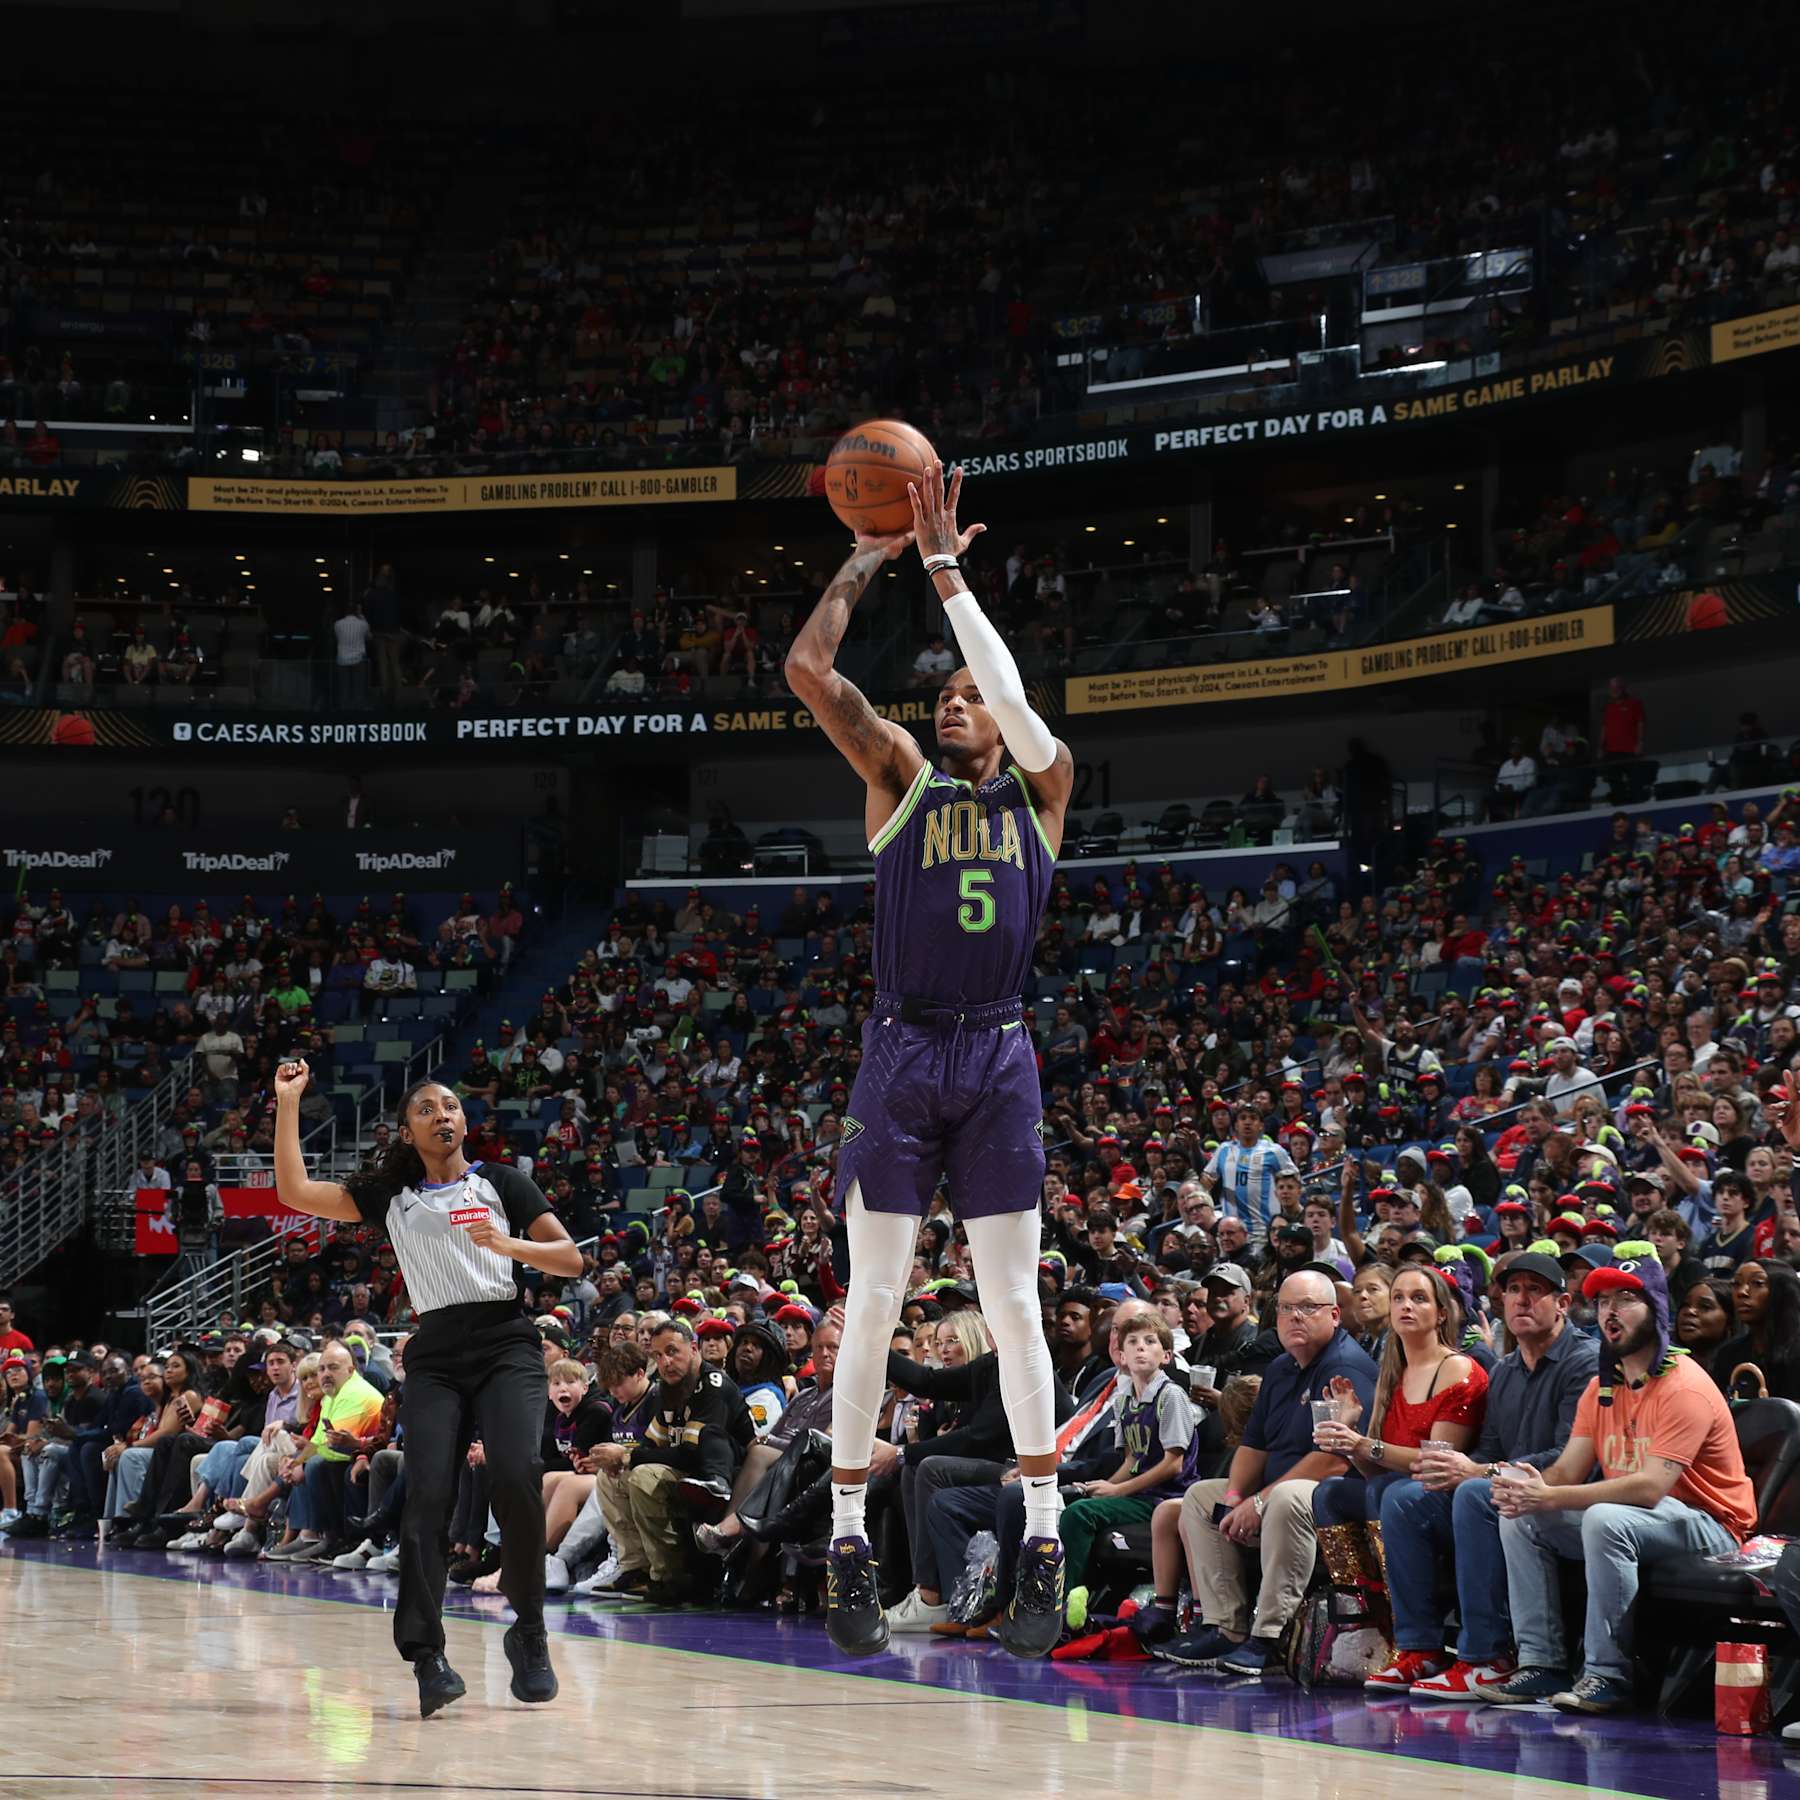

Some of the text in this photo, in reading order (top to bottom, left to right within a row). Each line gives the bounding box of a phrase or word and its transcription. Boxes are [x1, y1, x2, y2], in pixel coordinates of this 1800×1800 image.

[1154, 355, 1616, 452] PERFECT DAY FOR A SAME GAME PARLAY
[1024, 438, 1129, 470] SPORTSBOOK
[481, 476, 718, 501] GAMBLING PROBLEM? CALL 1-800-GAMBLER
[1361, 618, 1585, 675] GAMBLING PROBLEM? CALL 1-800-GAMBLER
[1088, 682, 1109, 691] Must
[1111, 681, 1121, 690] be
[1138, 677, 1156, 687] and
[1157, 673, 1200, 686] physically
[1202, 671, 1235, 683] present
[1266, 664, 1290, 675] Know
[1293, 662, 1316, 673] When
[1318, 660, 1328, 670] To
[1088, 694, 1108, 704] Stop
[1110, 691, 1137, 701] Before
[1139, 689, 1155, 699] You
[1225, 680, 1260, 691] Caesars
[1262, 673, 1326, 688] Entertainment
[456, 717, 570, 739] PERFECT
[576, 715, 627, 736] DAY
[633, 713, 683, 734] FOR
[689, 712, 708, 733] A
[712, 710, 788, 733] SAME
[874, 702, 934, 722] PARL
[197, 722, 428, 744] CAESARS SPORTSBOOK
[922, 801, 1025, 870] NOLA
[3, 849, 98, 870] TripADeal
[182, 851, 274, 872] TripADeal
[355, 851, 441, 872] TripADeal
[957, 868, 995, 933] 5
[450, 1210, 490, 1223] Emirates
